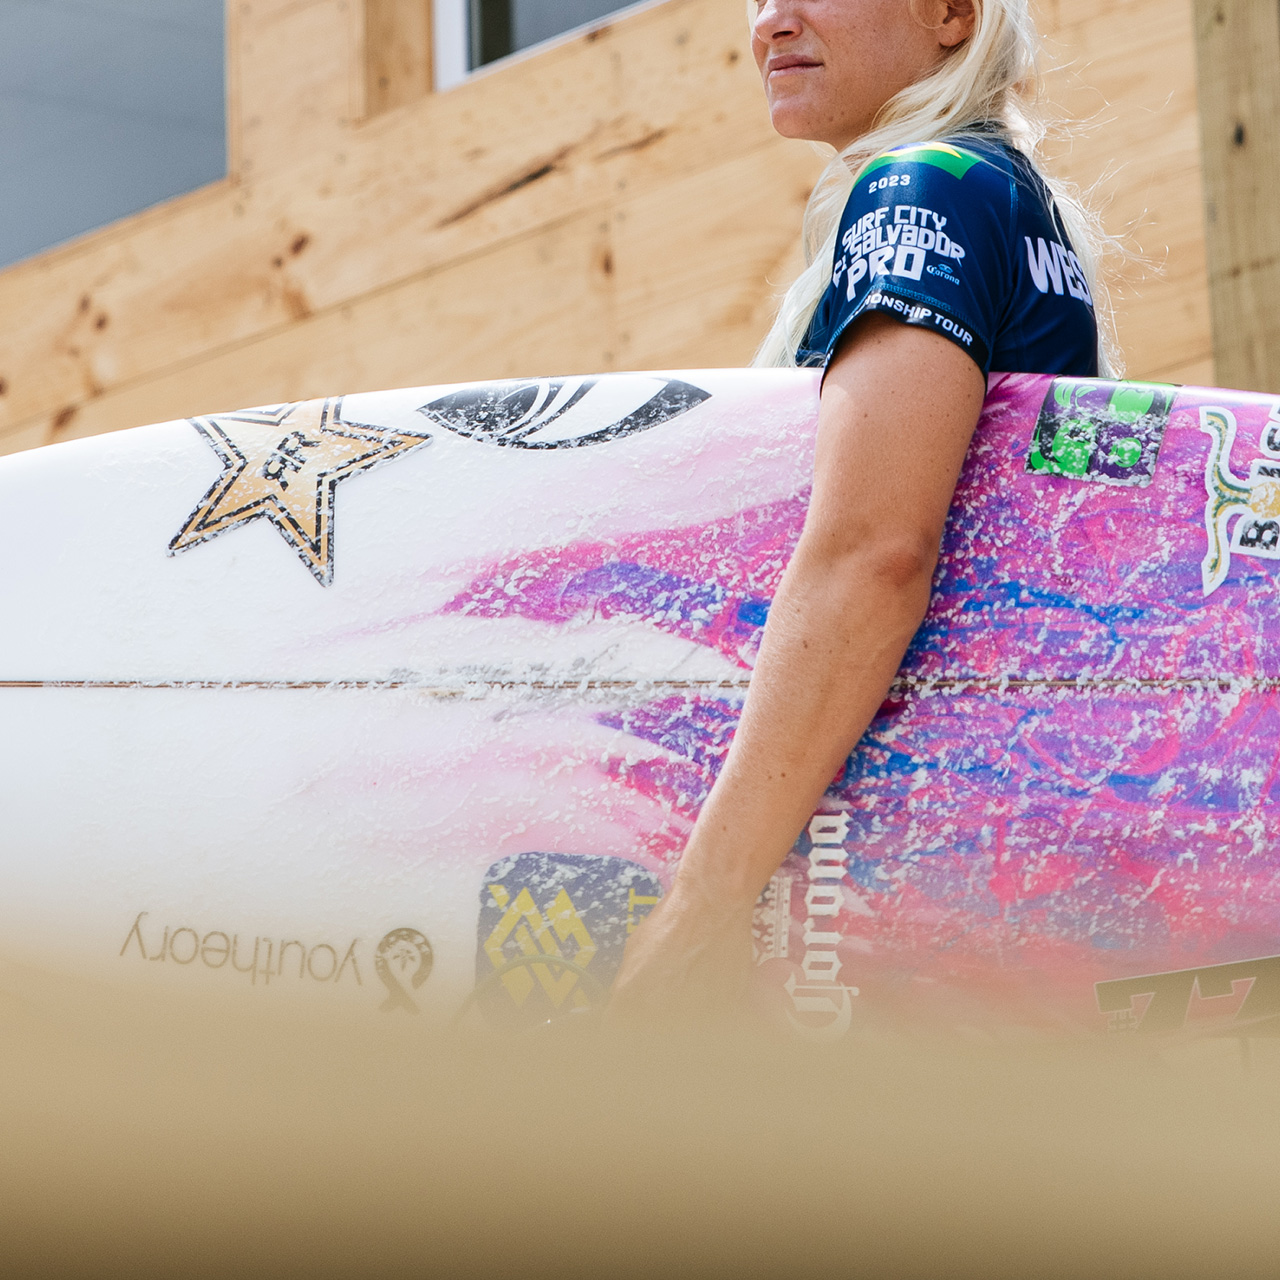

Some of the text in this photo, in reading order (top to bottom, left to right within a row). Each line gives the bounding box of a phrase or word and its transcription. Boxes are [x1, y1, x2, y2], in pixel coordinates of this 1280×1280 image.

[868, 174, 911, 195] 2023
[841, 205, 947, 253] SURF CITY
[846, 244, 927, 303] PRO
[926, 264, 960, 286] Corona
[934, 312, 974, 347] TOUR
[119, 910, 363, 986] youtheory
[782, 810, 861, 1042] Corona
